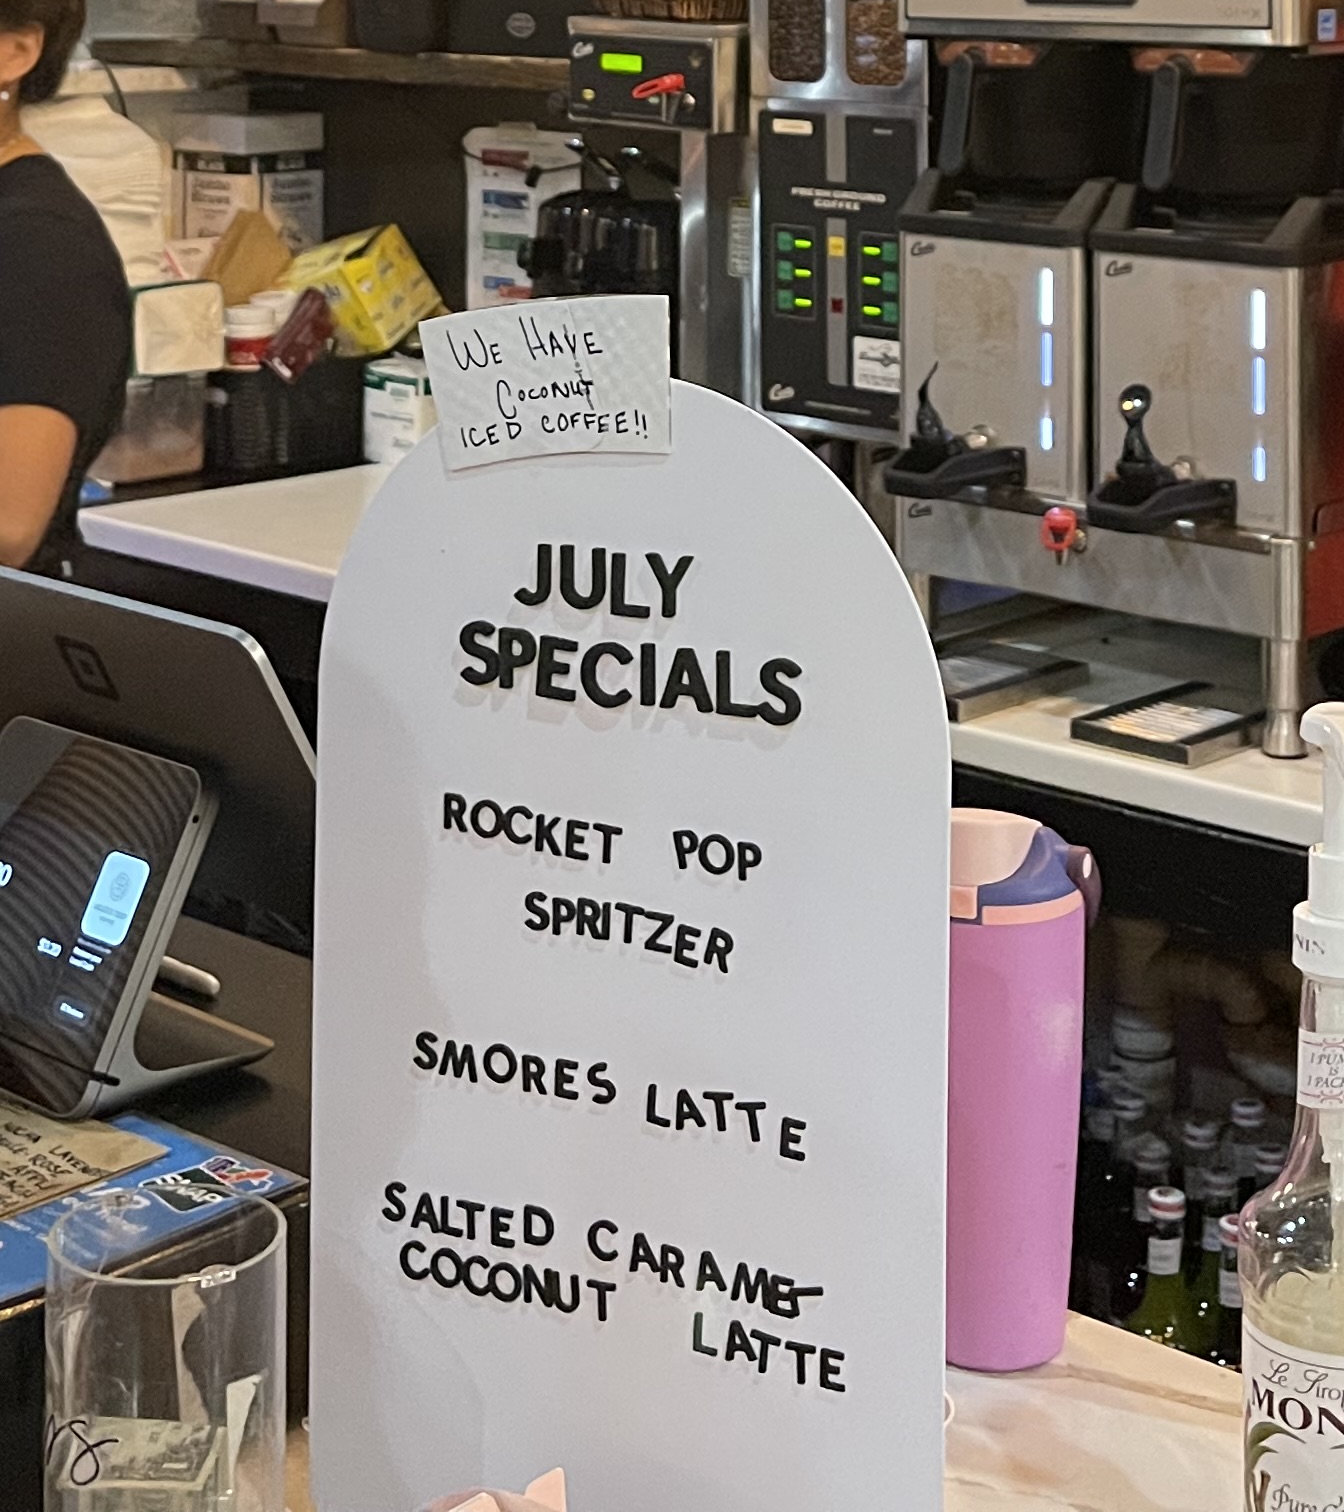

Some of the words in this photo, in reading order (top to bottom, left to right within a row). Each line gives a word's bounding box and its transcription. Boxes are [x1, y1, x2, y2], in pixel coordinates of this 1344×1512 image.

[813, 198, 861, 211] COFFEE
[446, 329, 503, 371] WE
[518, 316, 603, 362] HAVE
[461, 422, 522, 448] ICED
[513, 543, 694, 618] JULY
[459, 620, 803, 726] SPECIALS
[443, 791, 623, 864] ROCKET
[673, 828, 762, 881] POP
[523, 890, 734, 973] SPRITZER
[412, 1031, 617, 1105] SMORES
[645, 1083, 807, 1162] LATTE
[381, 1181, 555, 1248] SALTED
[399, 1240, 616, 1322] COCONUT
[692, 1312, 846, 1393] LATTE
[1261, 1359, 1290, 1388] Le
